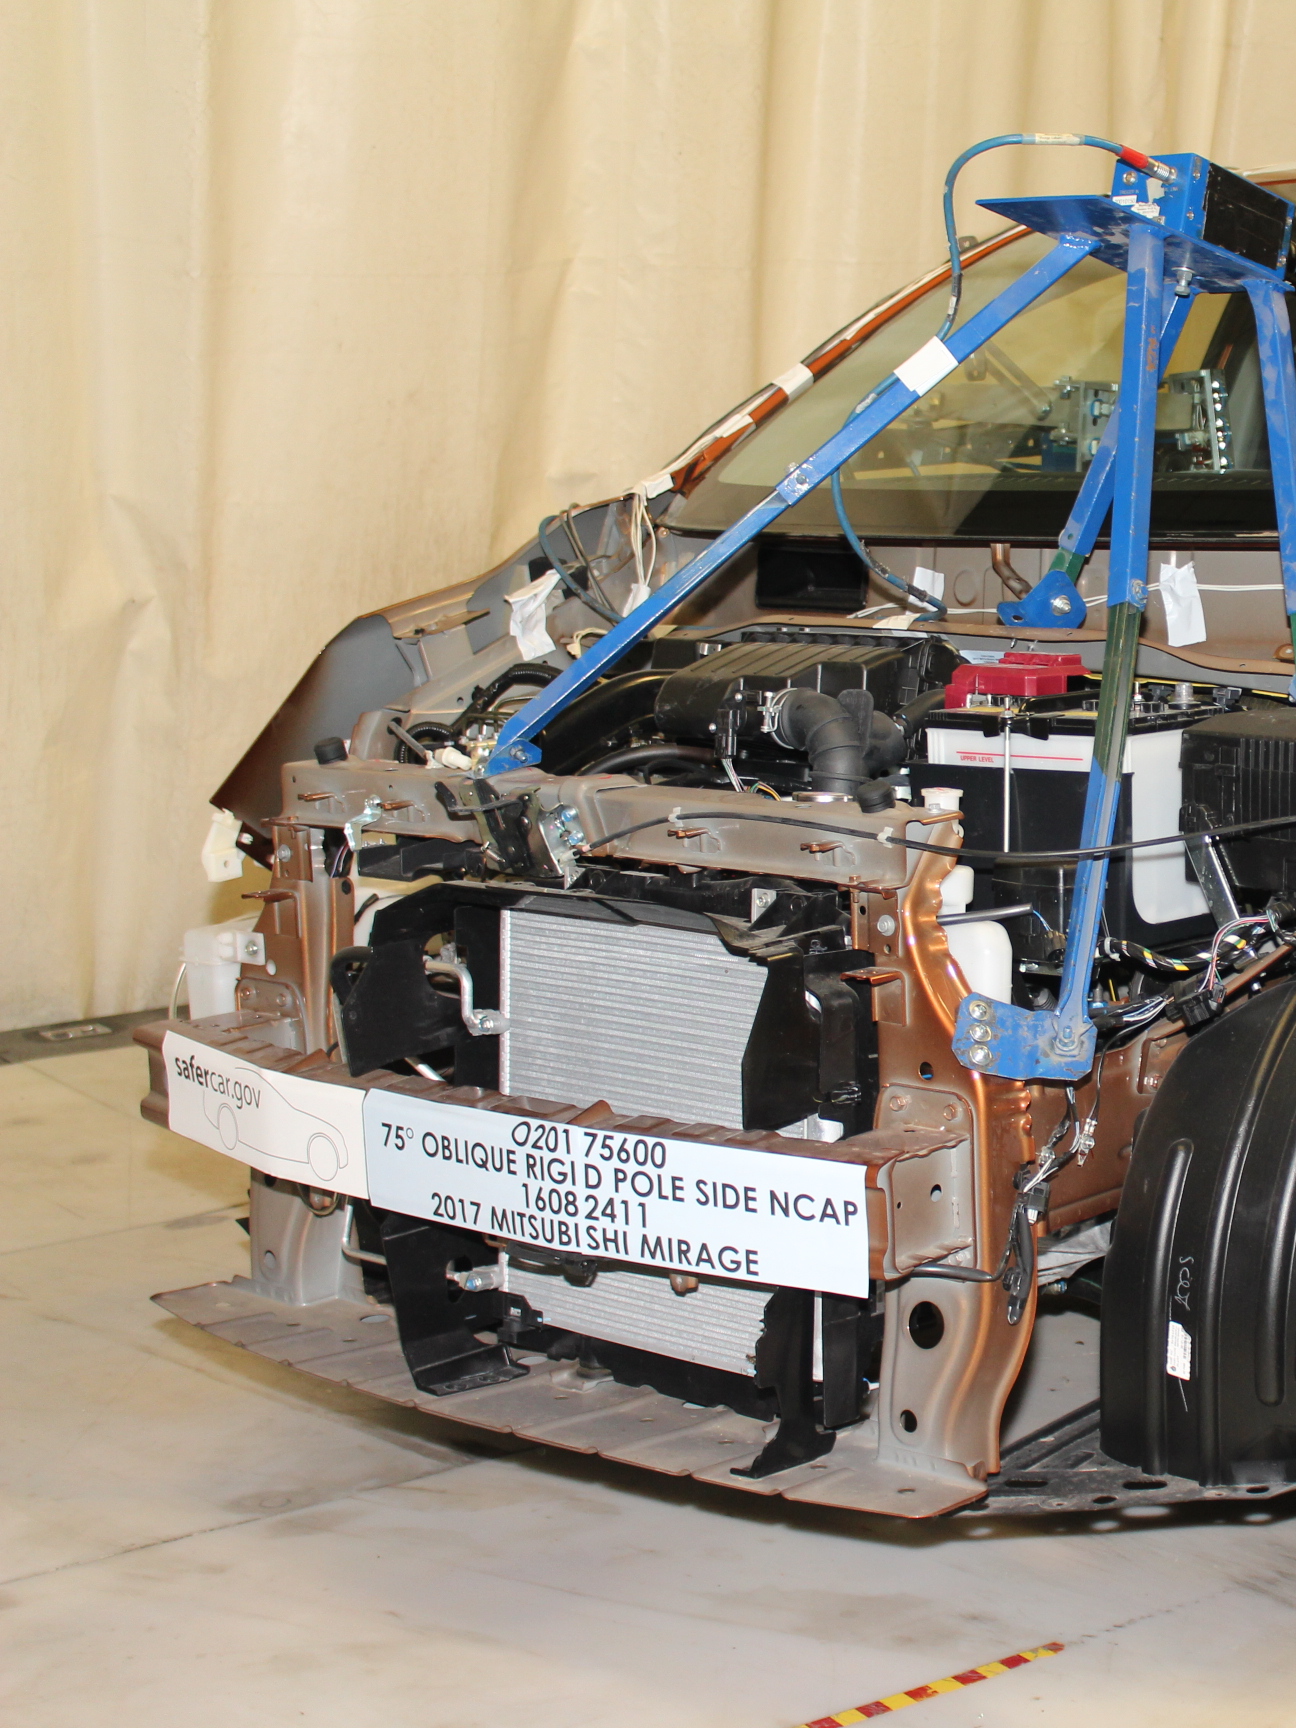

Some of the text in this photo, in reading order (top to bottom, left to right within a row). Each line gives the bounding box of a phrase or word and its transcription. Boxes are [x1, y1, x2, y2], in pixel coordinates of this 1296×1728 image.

[174, 1054, 261, 1110] safercar.gov
[422, 1131, 518, 1177] OBLIQUE
[525, 1151, 602, 1189] RIGID
[613, 1167, 686, 1203] POLE
[695, 1178, 758, 1214] SIDE
[769, 1189, 859, 1227] NCAP
[430, 1192, 760, 1277] 2017 MITSUBISHI MIRAGE
